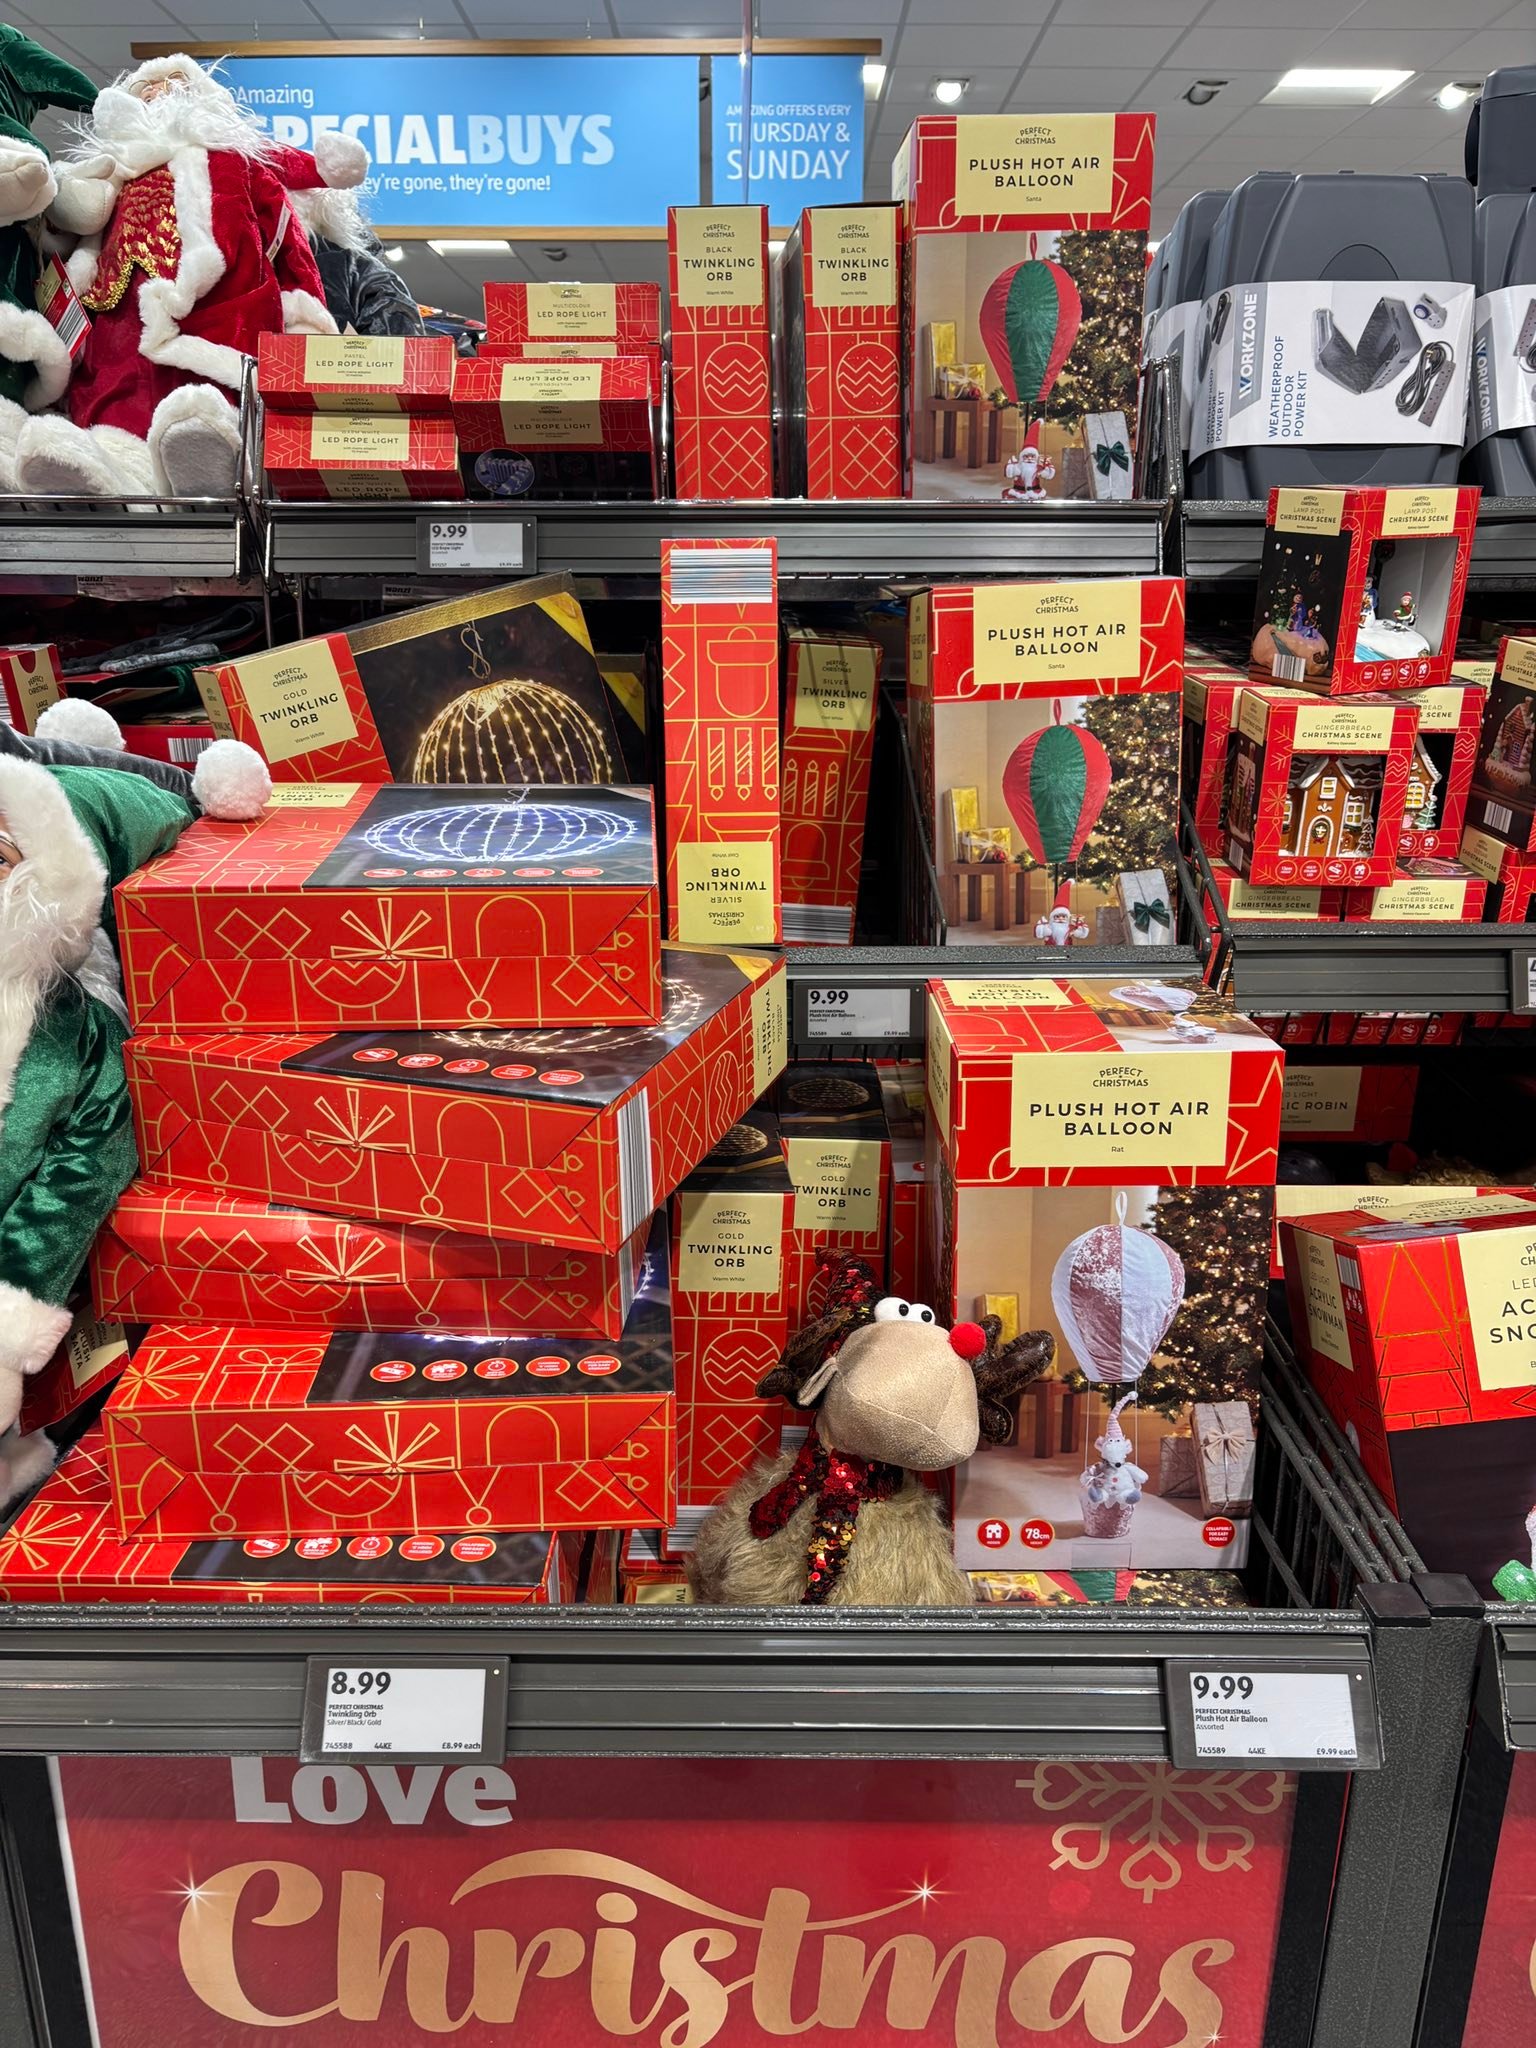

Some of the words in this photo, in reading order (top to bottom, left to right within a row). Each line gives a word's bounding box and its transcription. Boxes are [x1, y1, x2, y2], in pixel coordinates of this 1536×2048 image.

[237, 84, 314, 108] Amazing
[776, 104, 816, 116] OFFERS
[817, 104, 852, 116] EVERY
[835, 122, 851, 143] &
[1020, 126, 1052, 136] PERFECT
[1014, 137, 1056, 145] CHRISTMAS
[726, 149, 850, 181] SUNDAY
[968, 157, 1024, 172] PLUSH
[1031, 157, 1066, 170] HOT
[1071, 156, 1101, 169] AIR
[404, 177, 447, 195] gone,
[449, 173, 502, 195] they're
[505, 174, 551, 195] gone!
[994, 174, 1075, 188] BALLOON
[705, 246, 733, 254] BLACK
[683, 257, 756, 269] TWINKLING
[818, 258, 890, 270] TWINKLING
[706, 272, 733, 282] ORB
[841, 272, 867, 282] ORB
[537, 310, 554, 318] LED
[556, 310, 580, 318] ROPE
[582, 311, 608, 319] LIGHT
[1238, 292, 1258, 400] WORKZONE
[337, 360, 363, 368] ROPE
[1268, 335, 1285, 438] WEATHERPROOF
[1298, 371, 1308, 390] KIT
[1281, 375, 1295, 438] OUTDOOR
[1294, 393, 1306, 437] POWER
[1280, 514, 1315, 523] CHRISTMAS
[1316, 515, 1337, 523] SCENE
[1389, 515, 1426, 523] CHRISTMAS
[432, 525, 468, 538] 9.99
[1040, 596, 1075, 606] PERFECT
[1035, 605, 1080, 615] CHRISTMAS
[988, 626, 1046, 641] PLUSH
[1053, 624, 1089, 639] HOT
[1096, 623, 1127, 637] AIR
[1015, 641, 1099, 657] BALLOON
[272, 672, 308, 688] CHRISTMAS
[273, 667, 302, 681] PERFECT
[823, 678, 849, 686] SILVER
[282, 688, 308, 701] GOLD
[802, 687, 868, 700] TWINKLING
[259, 692, 339, 724] TWINKLING
[821, 700, 846, 709] ORB
[290, 713, 319, 729] ORB
[1302, 731, 1352, 739] CHRISTMAS
[711, 867, 741, 878] ORB
[685, 881, 767, 892] TWINKLING
[1378, 902, 1425, 910] CHRISTMAS
[810, 990, 849, 1004] 9.99
[1099, 1066, 1143, 1078] PERFECT
[1092, 1078, 1149, 1088] CHRISTMAS
[1029, 1102, 1103, 1117] PLUSH
[1114, 1102, 1161, 1116] HOT
[1169, 1101, 1210, 1116] AIR
[1304, 1101, 1348, 1110] ROBIN
[1064, 1121, 1173, 1136] BALLOON
[1111, 1145, 1125, 1153] Rat
[820, 1154, 848, 1162] PERFECT
[816, 1161, 852, 1169] CHRISTMAS
[821, 1175, 846, 1183] GOLD
[794, 1185, 872, 1197] TWINKLING
[818, 1198, 846, 1208] ORB
[1358, 1195, 1389, 1204] PERFECT
[717, 1209, 747, 1218] PERFECT
[718, 1232, 744, 1240] GOLD
[688, 1244, 773, 1255] TWINKLING
[714, 1258, 745, 1268] ORB
[1308, 1303, 1344, 1332] SNOWMAN
[70, 1333, 85, 1370] SANTA
[79, 1328, 92, 1363] PLUSH
[1025, 1528, 1050, 1540] 78cm
[331, 1671, 392, 1695] 8.99
[1193, 1675, 1254, 1700] 9.99
[328, 1710, 362, 1719] Twinkling
[364, 1710, 377, 1718] Orb
[1195, 1714, 1215, 1722] Plush
[1241, 1715, 1268, 1723] Balloon
[367, 1718, 382, 1726] Gold
[1197, 1746, 1226, 1754] 745589
[1247, 1747, 1266, 1755] 44KE
[1316, 1747, 1338, 1756] £9.99
[1338, 1747, 1356, 1756] each
[232, 1756, 517, 1826] Love
[178, 1848, 1237, 2048] Christmas
